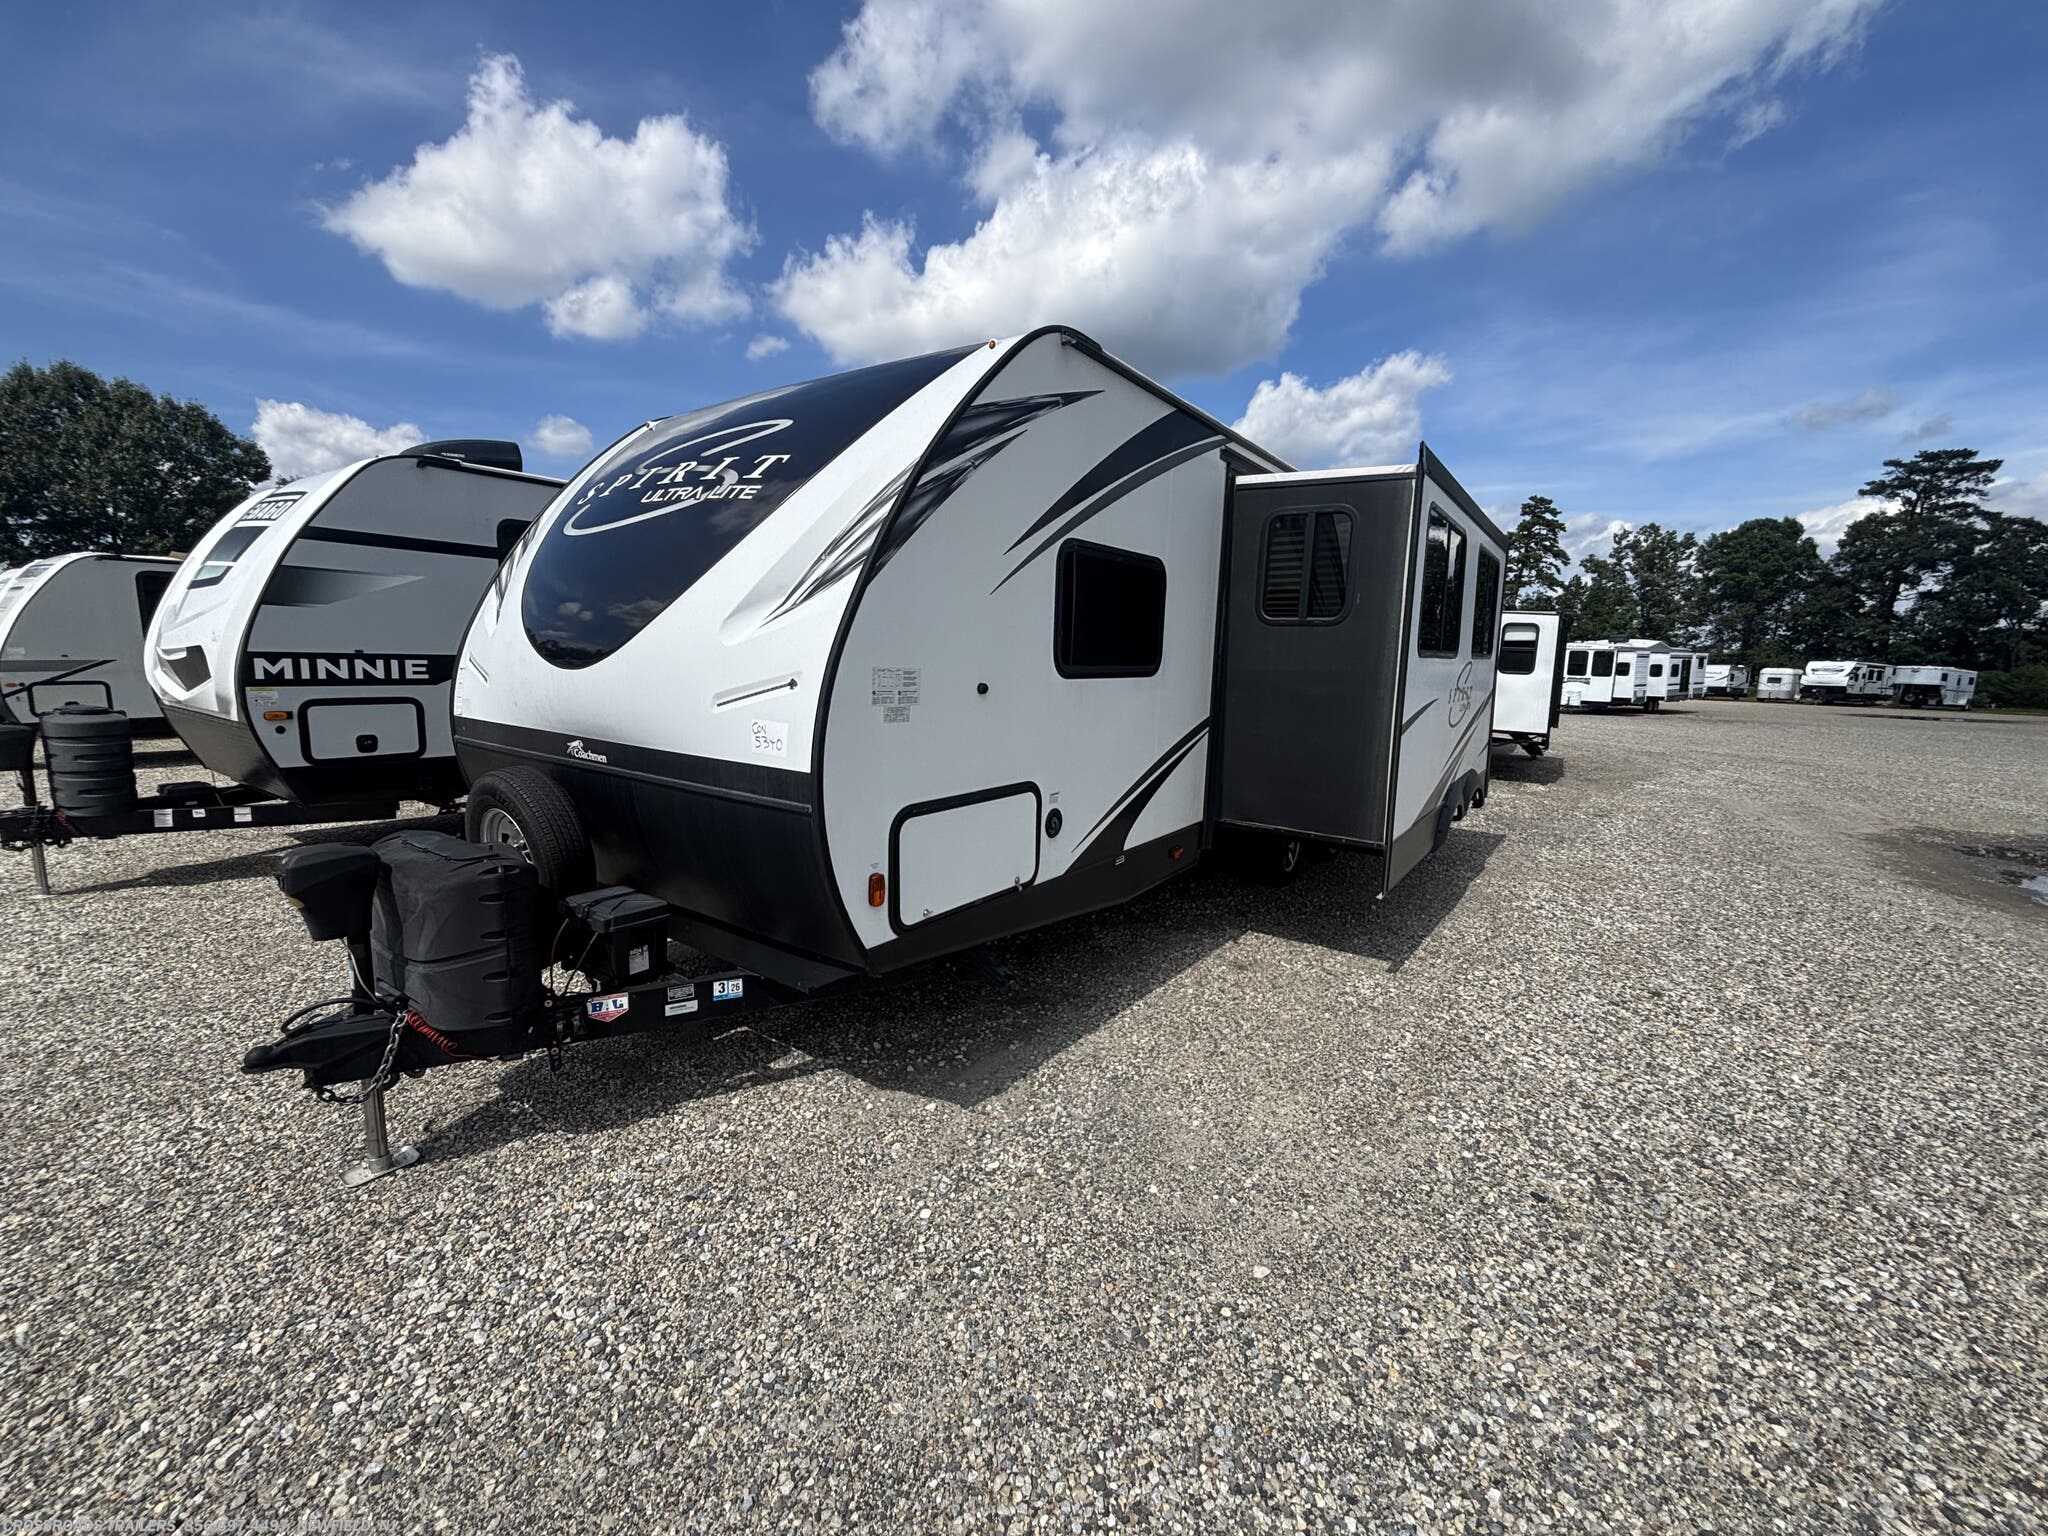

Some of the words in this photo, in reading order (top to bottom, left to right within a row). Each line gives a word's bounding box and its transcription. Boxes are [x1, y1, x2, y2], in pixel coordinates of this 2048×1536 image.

[577, 454, 791, 505] SPIRIT
[640, 485, 703, 503] ULTRA
[708, 485, 762, 499] LITE
[253, 657, 430, 680] MINNIE
[573, 748, 608, 764] Coachmen
[718, 982, 726, 994] 3
[730, 983, 741, 992] 26
